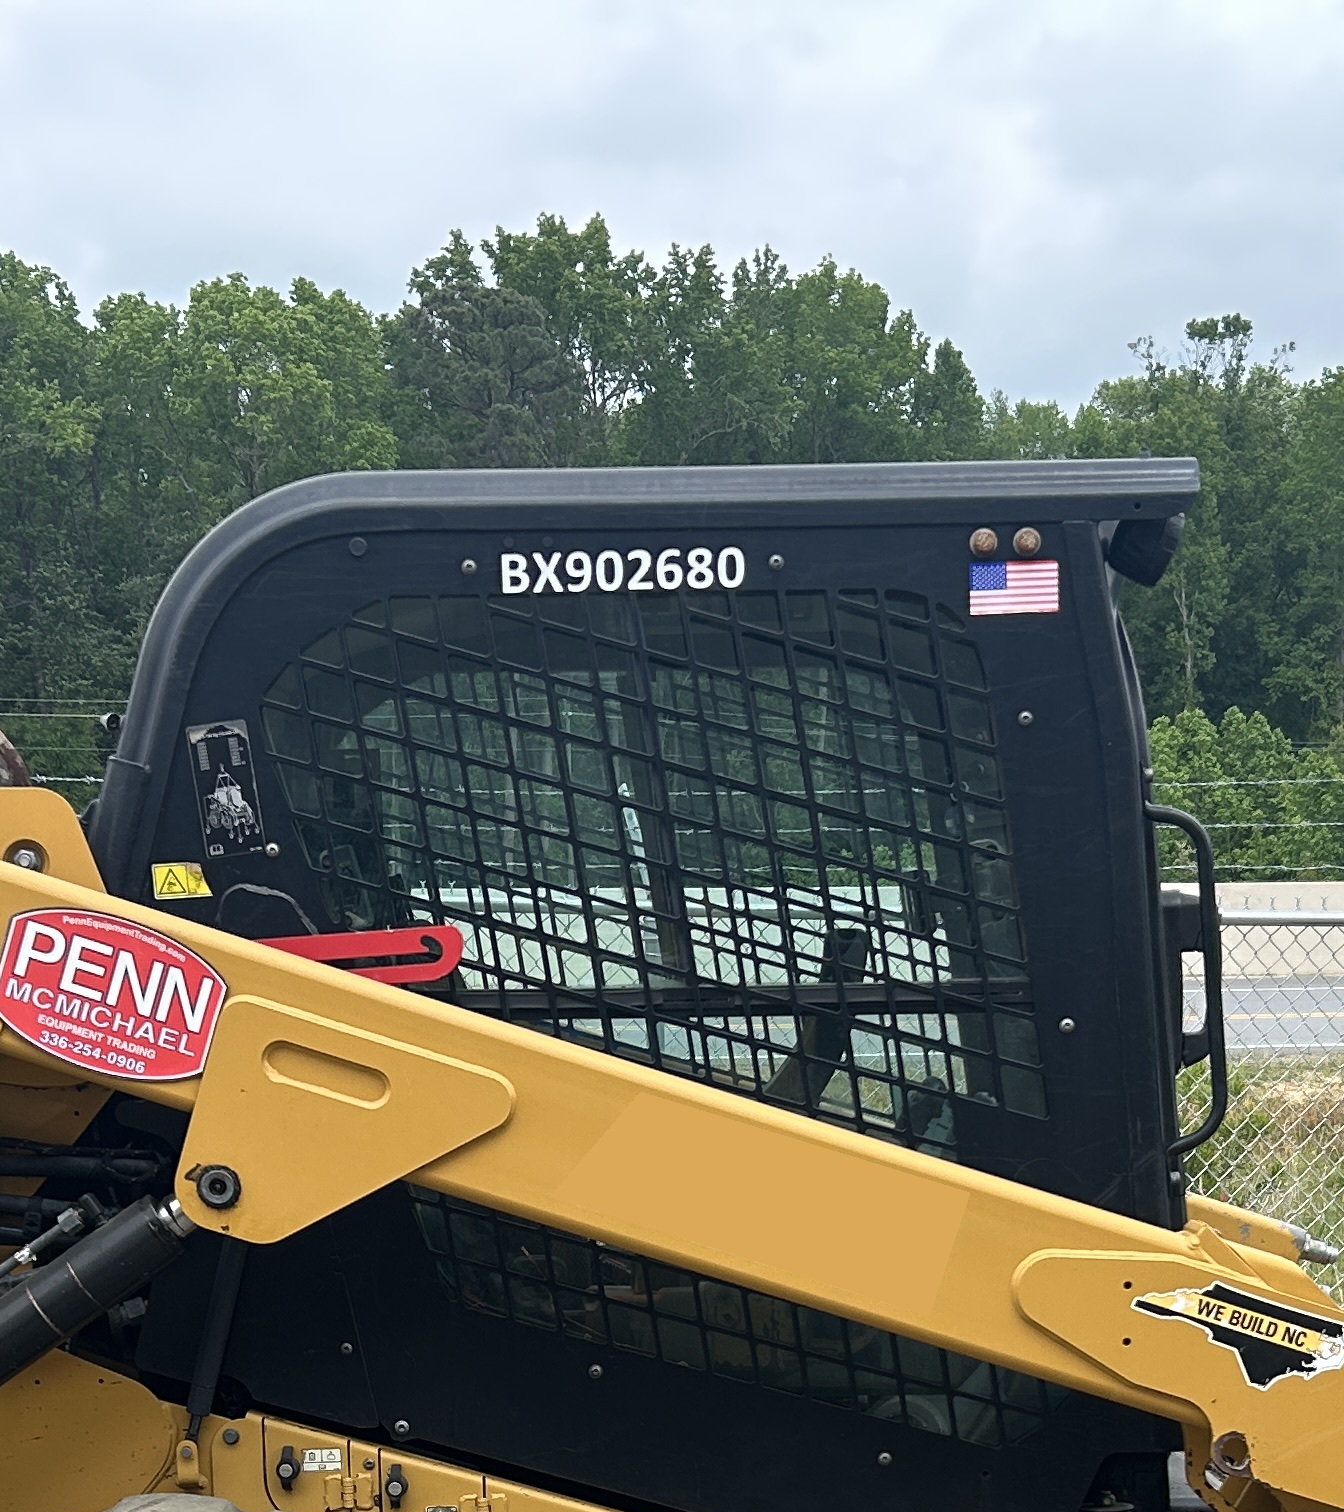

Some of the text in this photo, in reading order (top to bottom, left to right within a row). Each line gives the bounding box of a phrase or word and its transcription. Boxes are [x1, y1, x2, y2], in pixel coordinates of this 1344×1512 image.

[500, 547, 747, 594] BX902680
[62, 915, 186, 962] PennEquipmentTrading.com
[13, 920, 214, 1033] PENN
[37, 1013, 156, 1060] EQUIPMENT TRADING
[39, 1030, 146, 1074] 336-254-0906
[1197, 1299, 1308, 1347] WE BUILD NC
